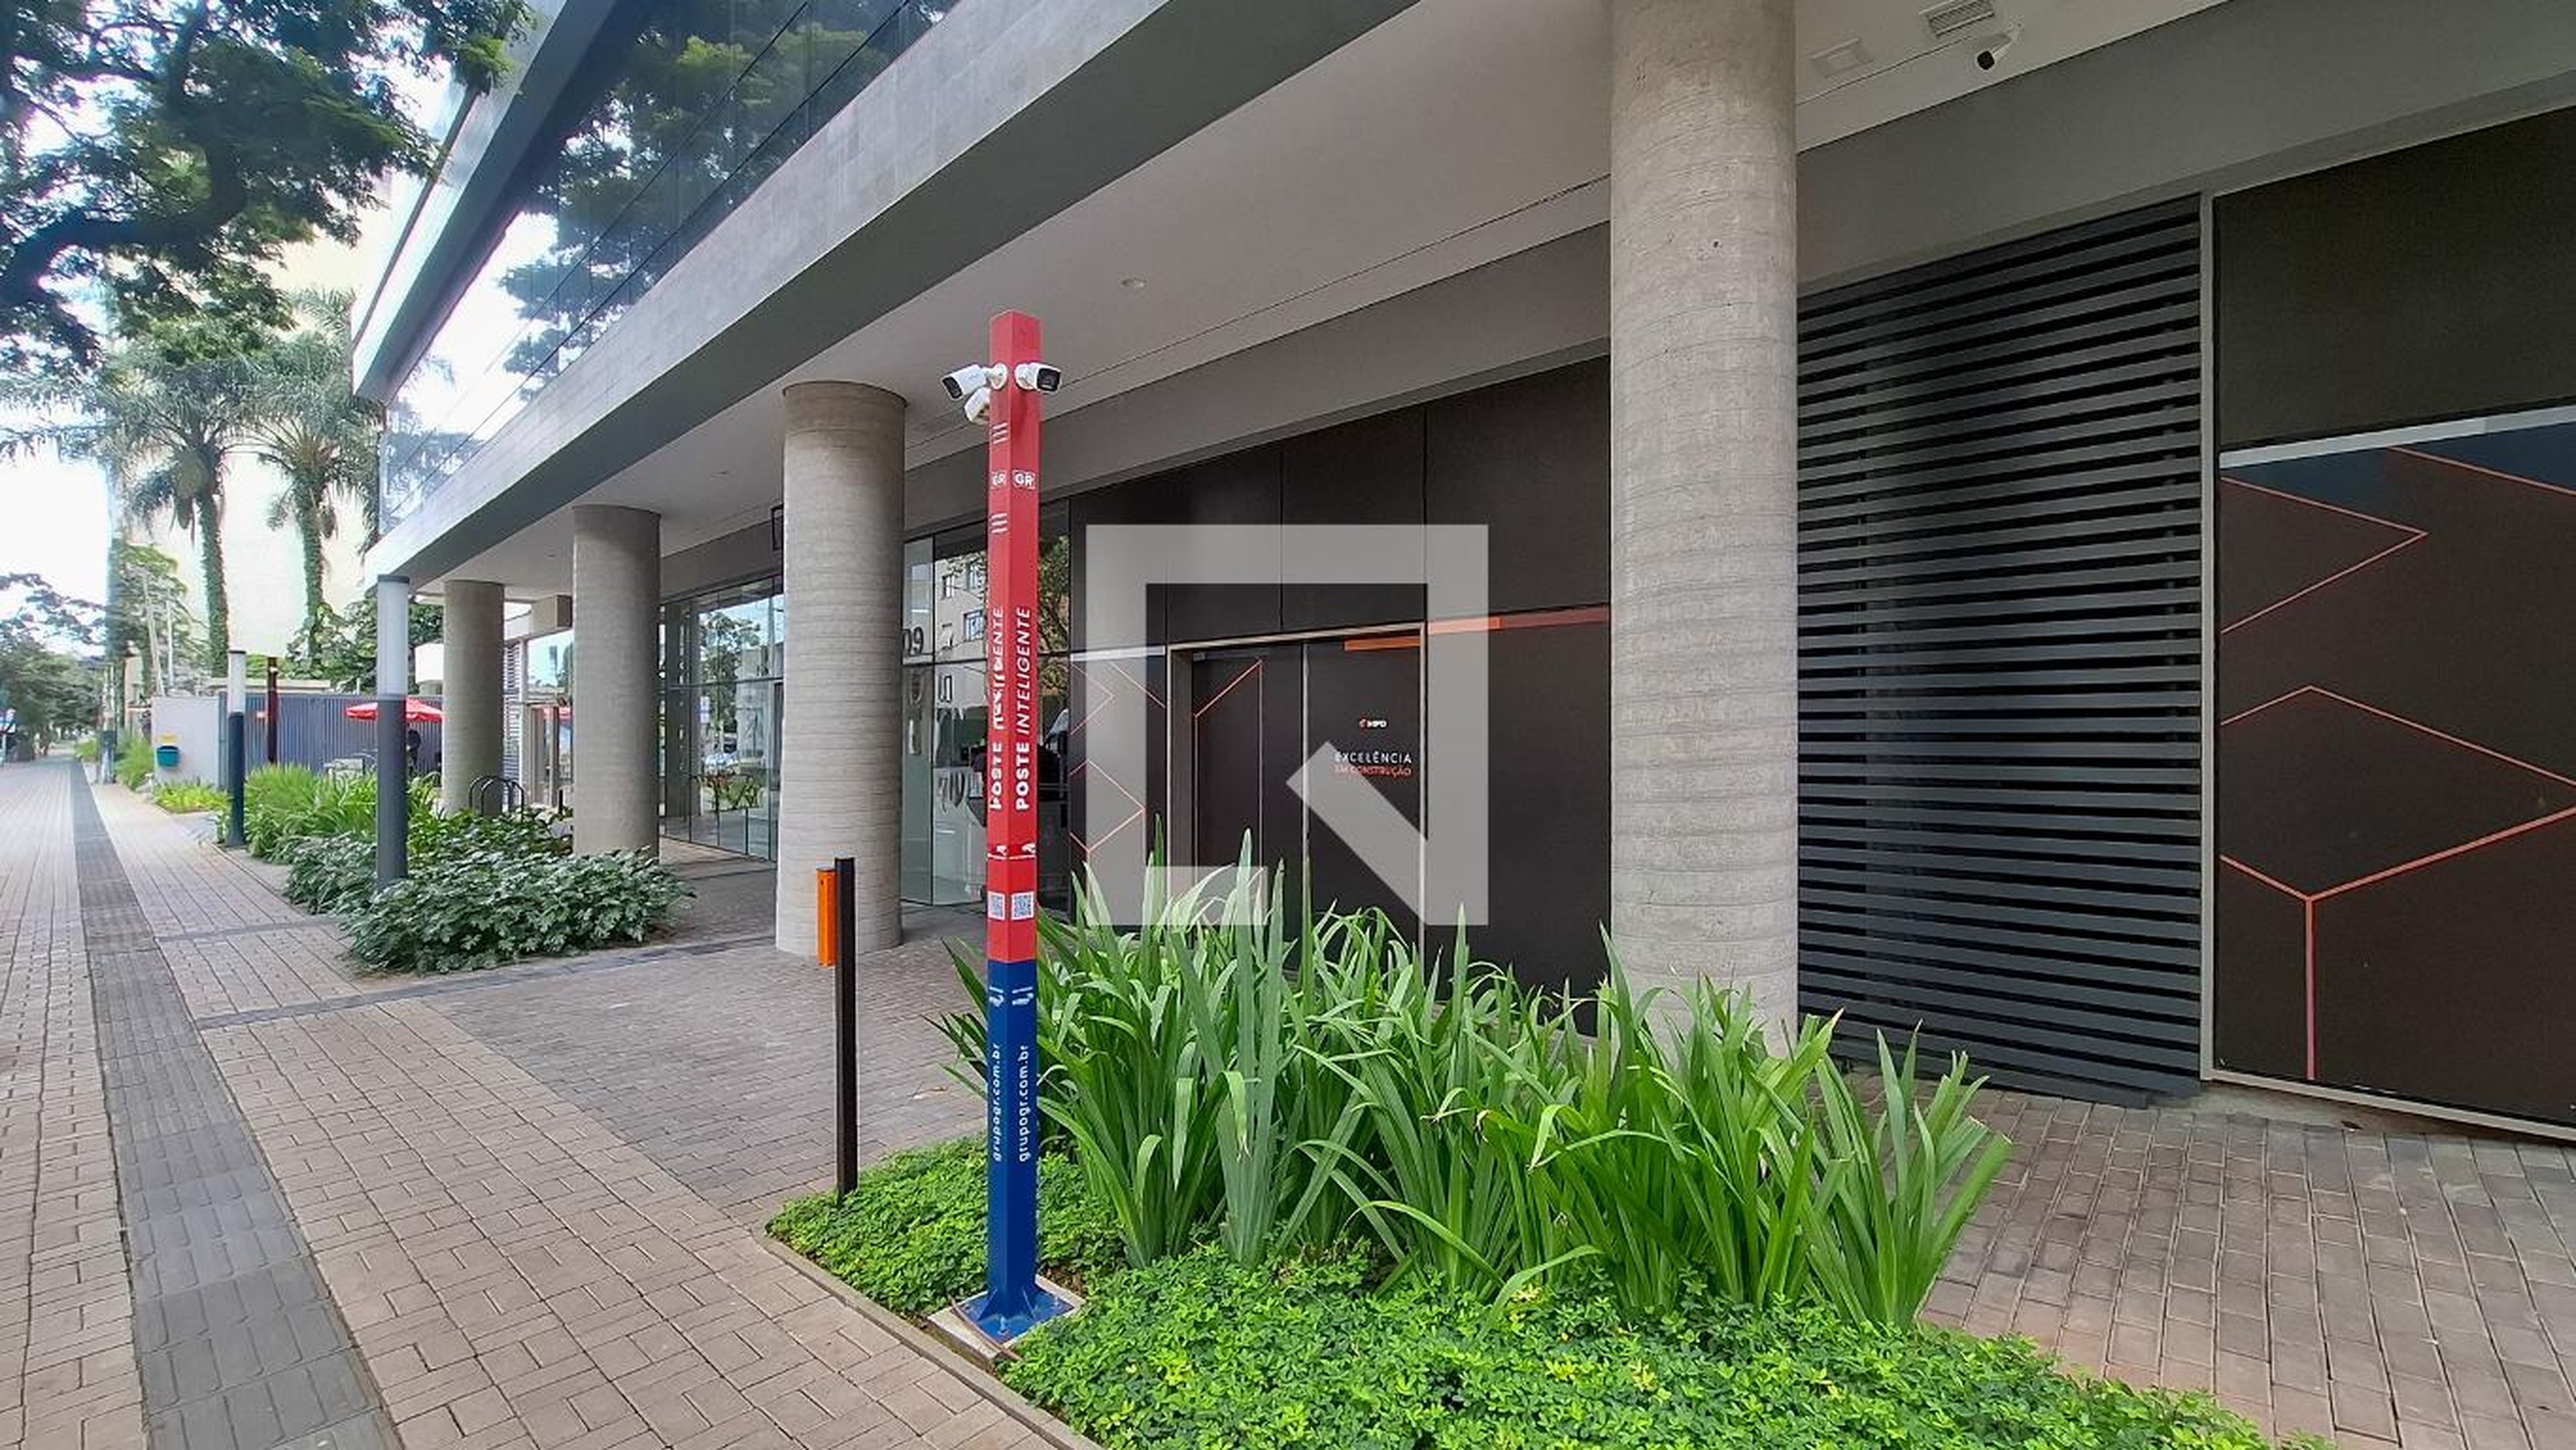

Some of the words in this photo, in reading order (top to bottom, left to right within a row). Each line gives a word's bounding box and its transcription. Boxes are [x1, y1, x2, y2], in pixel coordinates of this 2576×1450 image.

[1015, 473, 1032, 486] GR
[1016, 607, 1030, 735] INTELIGENTE
[1016, 742, 1030, 810] POSTE
[1334, 750, 1412, 763] EXCELÊNCIA
[992, 1043, 1002, 1162] grupogr.com.br
[1018, 1044, 1032, 1162] grupogr.com.br
